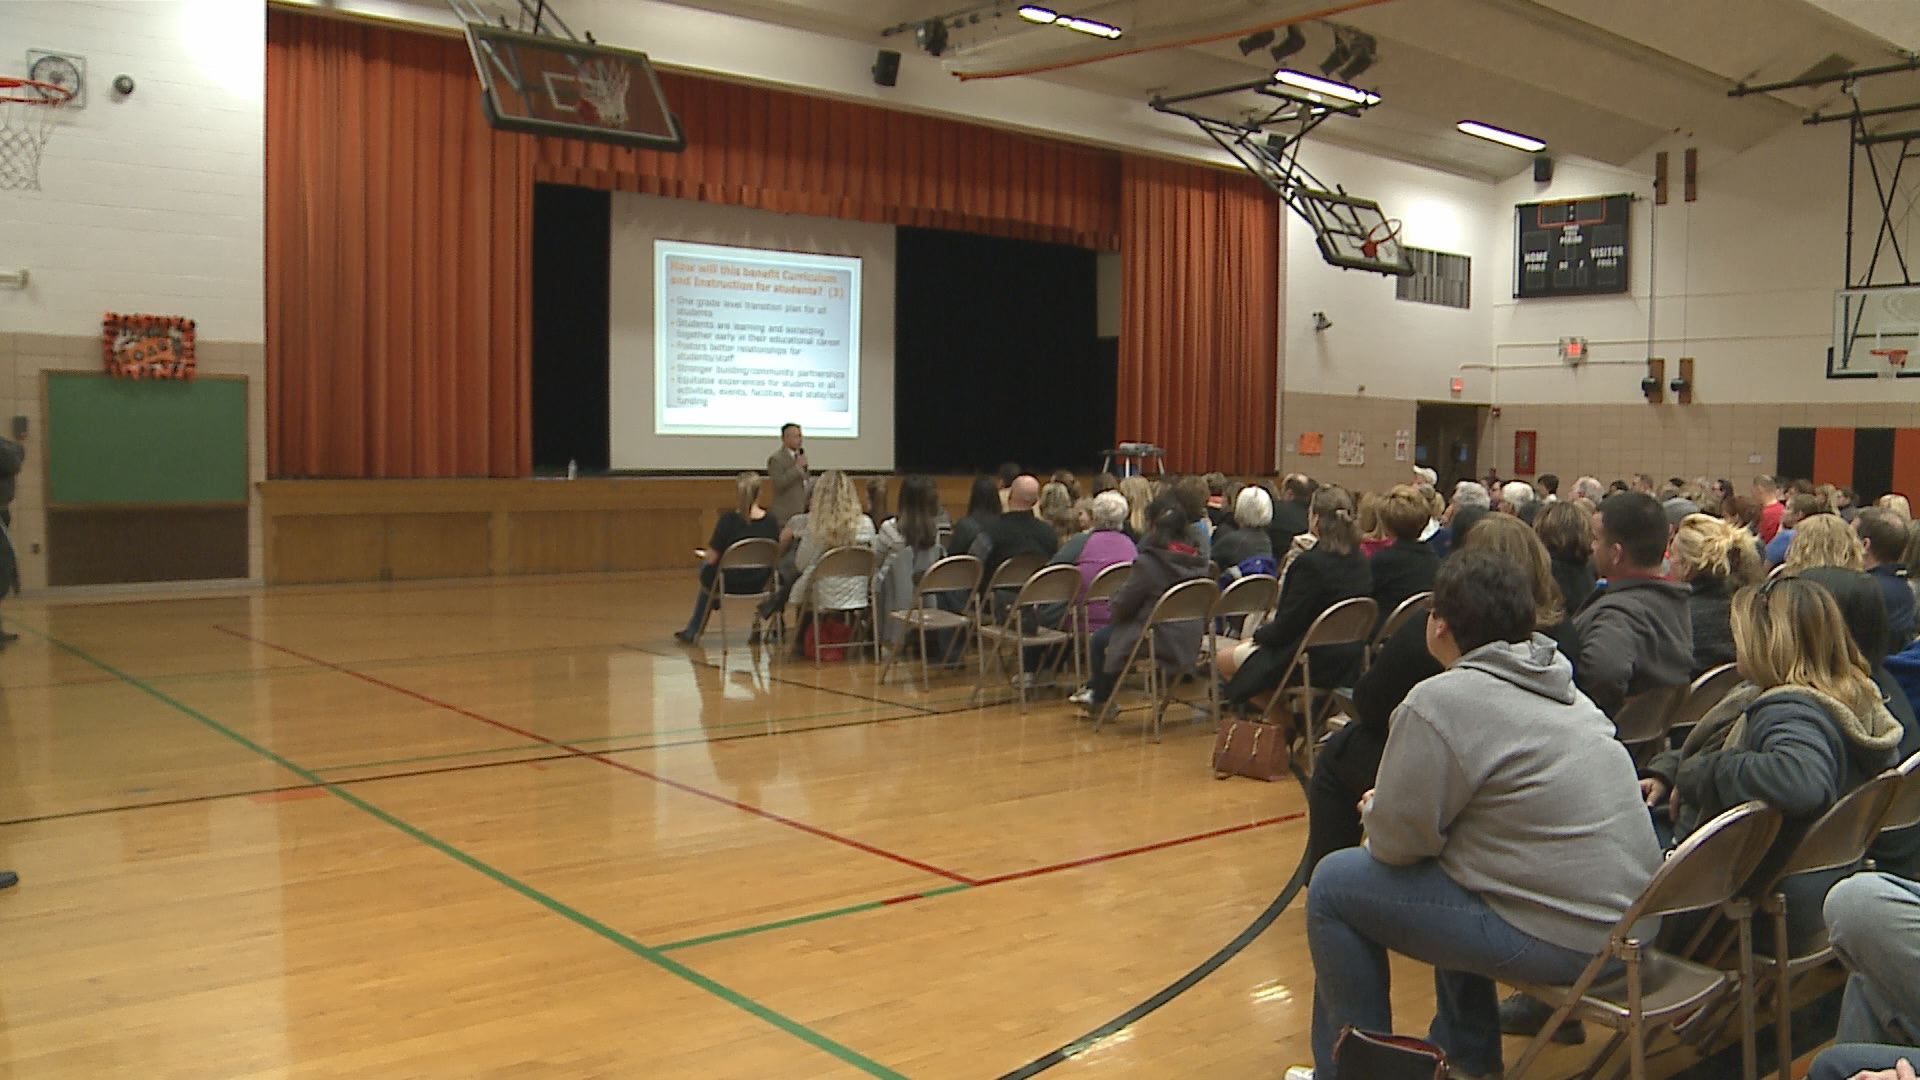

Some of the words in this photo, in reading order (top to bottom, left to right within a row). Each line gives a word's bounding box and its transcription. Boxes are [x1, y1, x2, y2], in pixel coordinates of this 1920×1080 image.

[1524, 251, 1548, 263] HOME
[1590, 246, 1624, 259] VISITOR
[698, 264, 718, 274] will
[720, 265, 740, 276] this
[743, 267, 779, 278] benefit
[782, 270, 837, 283] Curriculum
[671, 277, 690, 286] and
[694, 278, 753, 290] Instruction
[696, 299, 720, 307] grade
[745, 302, 782, 311] transition
[785, 305, 801, 313] plan
[677, 319, 713, 329] Students
[768, 325, 783, 333] and
[677, 330, 712, 339] together
[715, 333, 734, 342] early
[748, 335, 766, 344] their
[769, 336, 813, 345] educational
